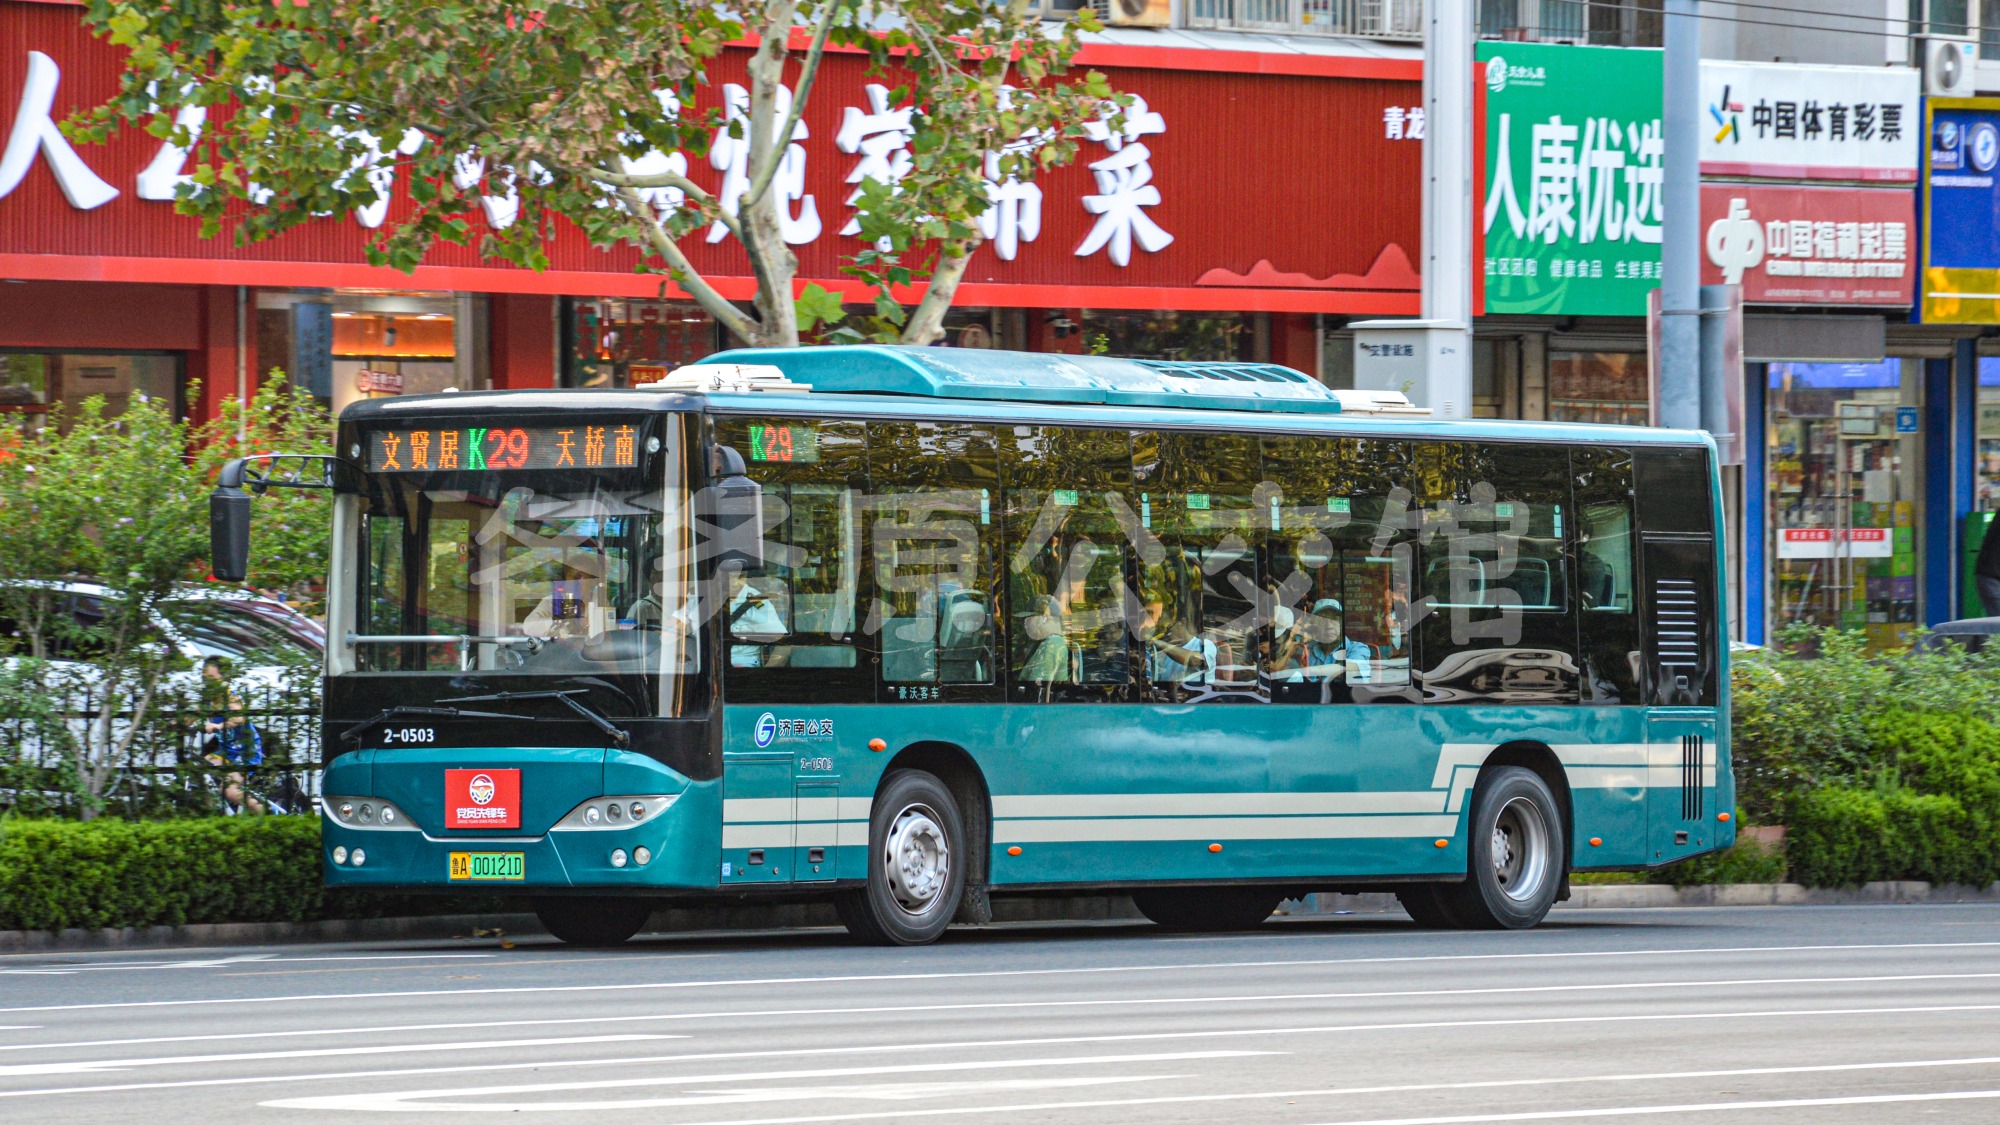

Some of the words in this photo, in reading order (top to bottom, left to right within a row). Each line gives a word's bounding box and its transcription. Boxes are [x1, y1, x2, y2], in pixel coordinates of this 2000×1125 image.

[1752, 98, 1904, 142] 中国体育彩票
[1483, 113, 1664, 245] 人康优选
[1765, 219, 1906, 260] 中国福利彩票
[1550, 258, 1602, 279] 健康食品
[468, 428, 529, 470] K29
[556, 424, 635, 467] 天桥南
[749, 425, 793, 462] K29
[899, 686, 939, 699] 豪沃客车
[383, 728, 434, 743] 2-0503
[778, 718, 833, 736] 济南公交
[800, 758, 833, 770] 2-0503
[456, 807, 507, 818] 党员先锋车
